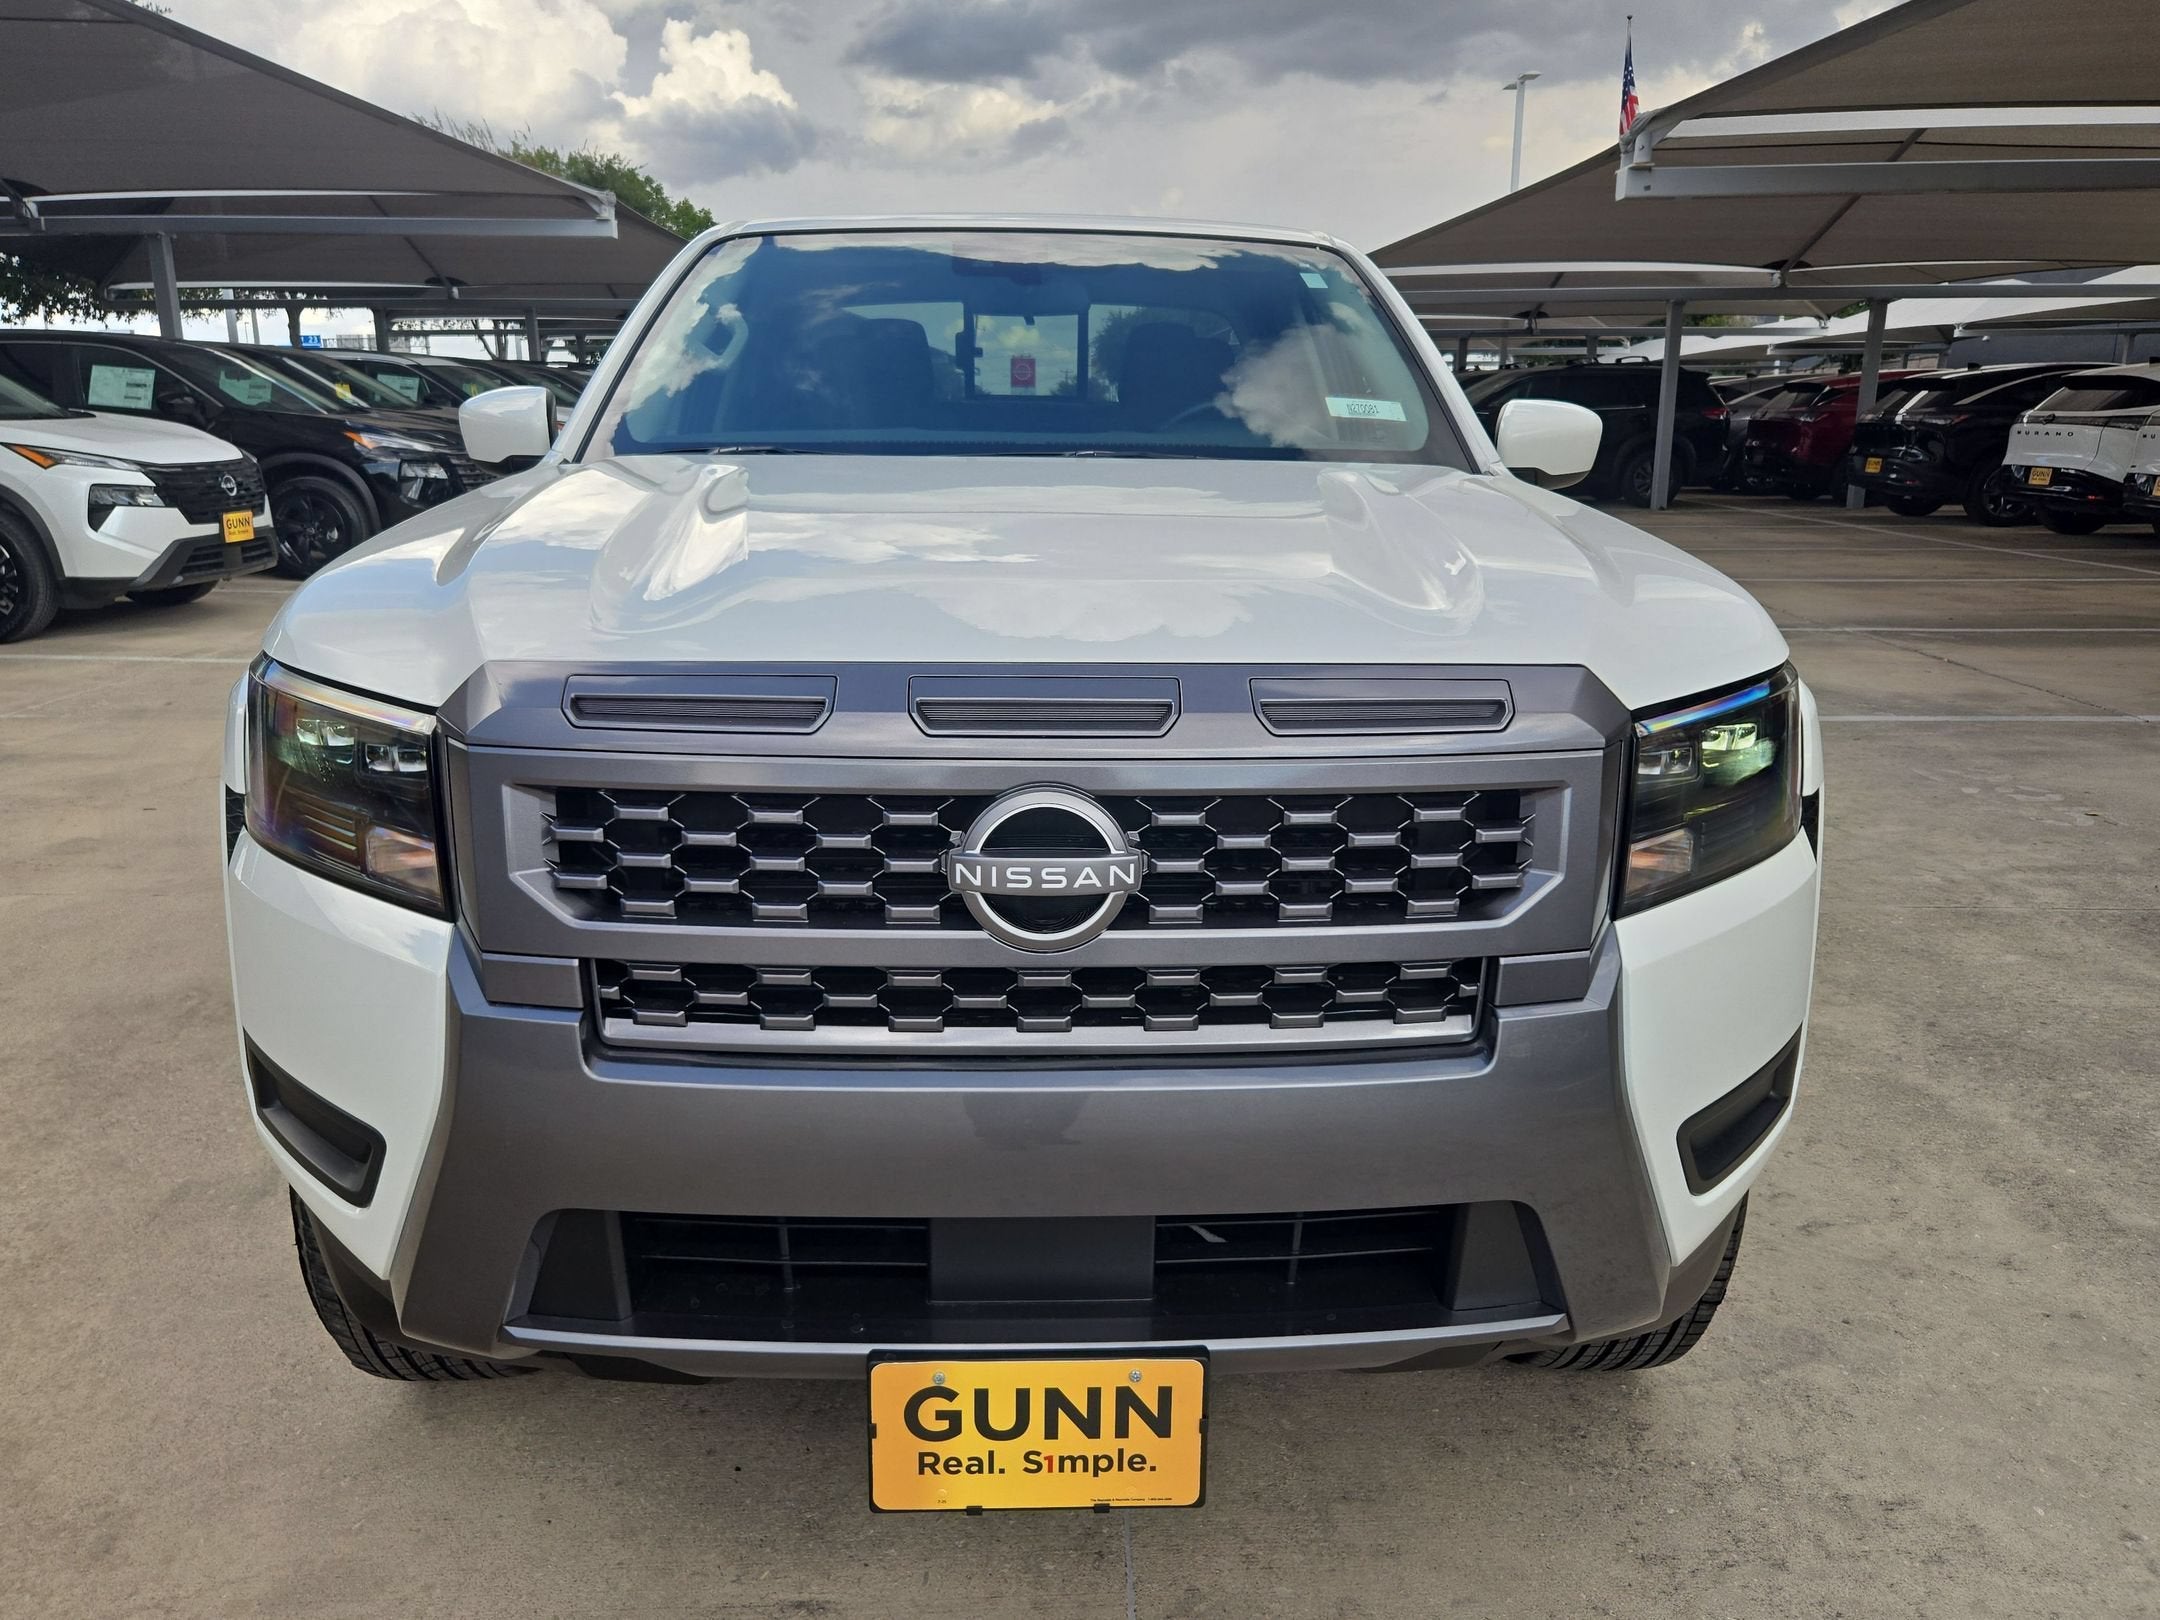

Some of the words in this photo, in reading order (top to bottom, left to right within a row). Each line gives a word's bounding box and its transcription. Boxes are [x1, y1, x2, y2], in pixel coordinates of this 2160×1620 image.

[226, 517, 250, 530] GUNN
[955, 863, 1135, 889] NISSAN
[903, 1385, 1173, 1441] GUNN
[917, 1450, 1006, 1475] Real.
[1022, 1447, 1157, 1478] S1mple.
